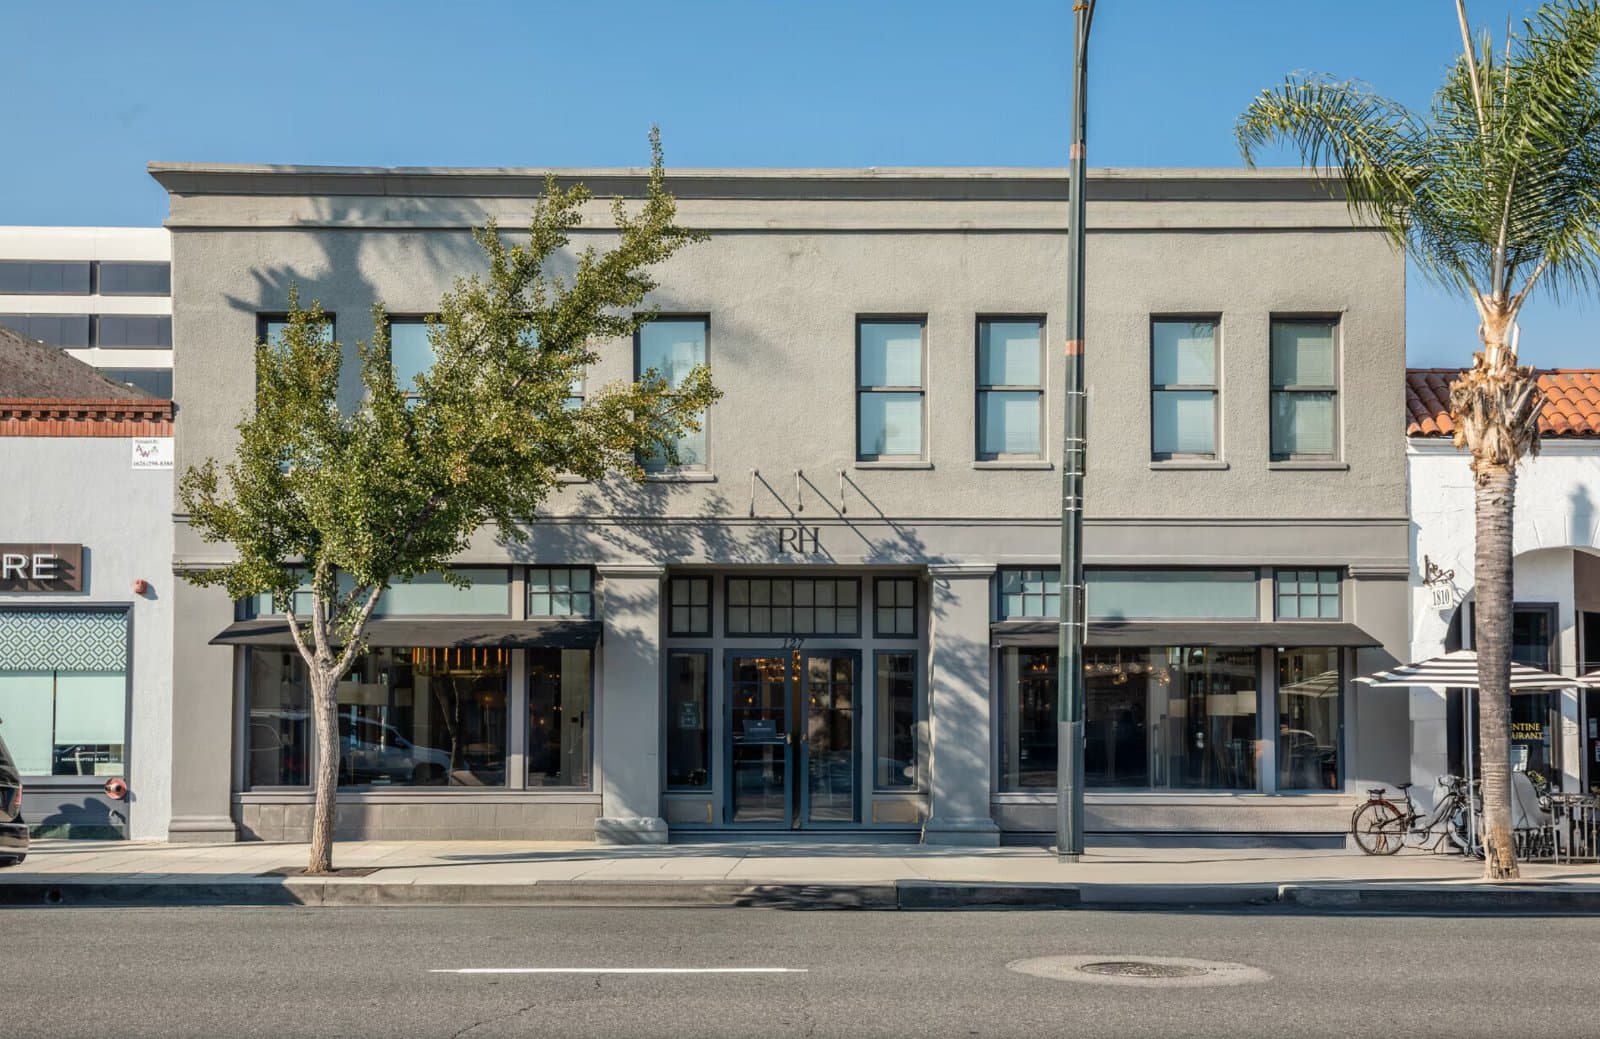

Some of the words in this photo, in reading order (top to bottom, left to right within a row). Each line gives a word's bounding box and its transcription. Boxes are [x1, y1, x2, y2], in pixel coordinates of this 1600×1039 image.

[777, 527, 819, 553] RH
[1433, 589, 1450, 606] 1810
[1511, 732, 1543, 740] URANT
